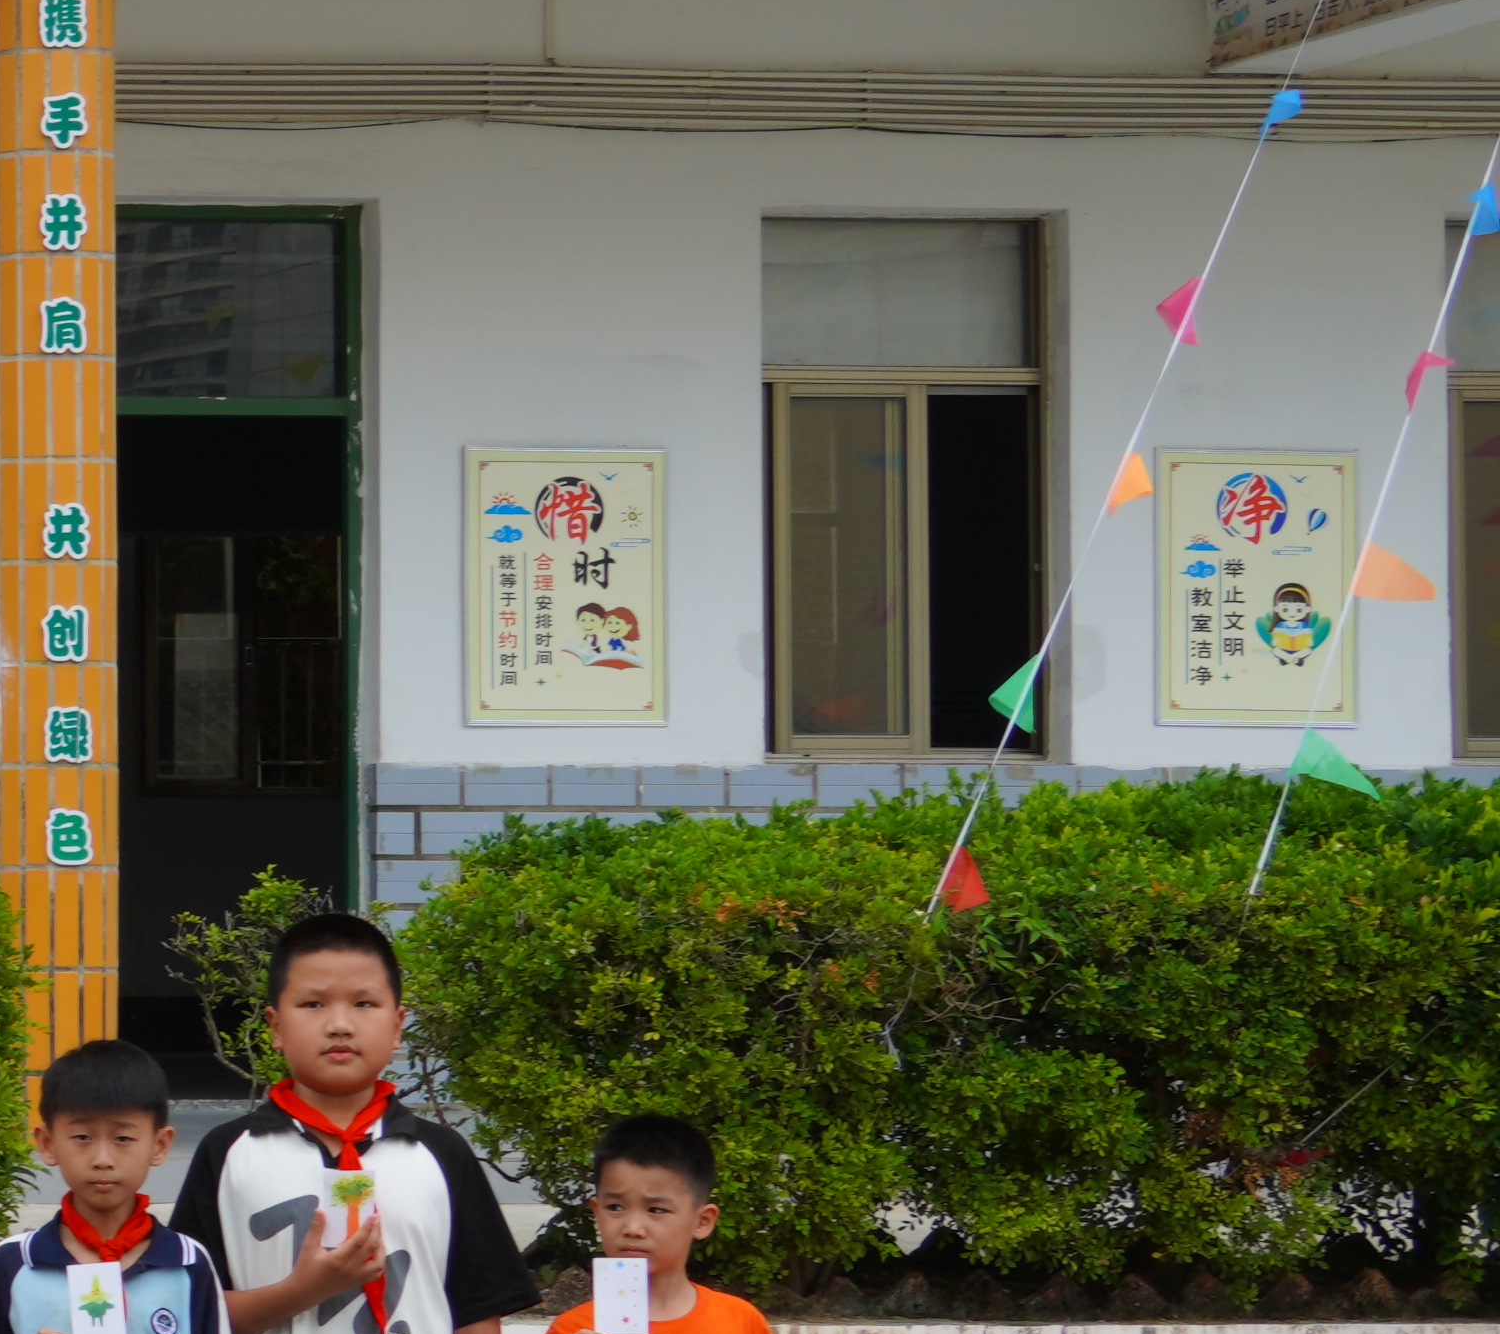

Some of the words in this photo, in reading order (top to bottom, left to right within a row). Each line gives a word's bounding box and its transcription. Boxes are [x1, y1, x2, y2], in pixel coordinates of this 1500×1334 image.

[538, 481, 601, 545] 惜
[1221, 473, 1285, 546] 净
[533, 552, 555, 667] 合理安排时间
[572, 546, 616, 590] 时
[1222, 557, 1246, 657] 举止文明
[497, 554, 518, 687] 就等于节约时间
[1190, 587, 1213, 686] 教室洁净
[43, 503, 93, 868] 共创绿色
